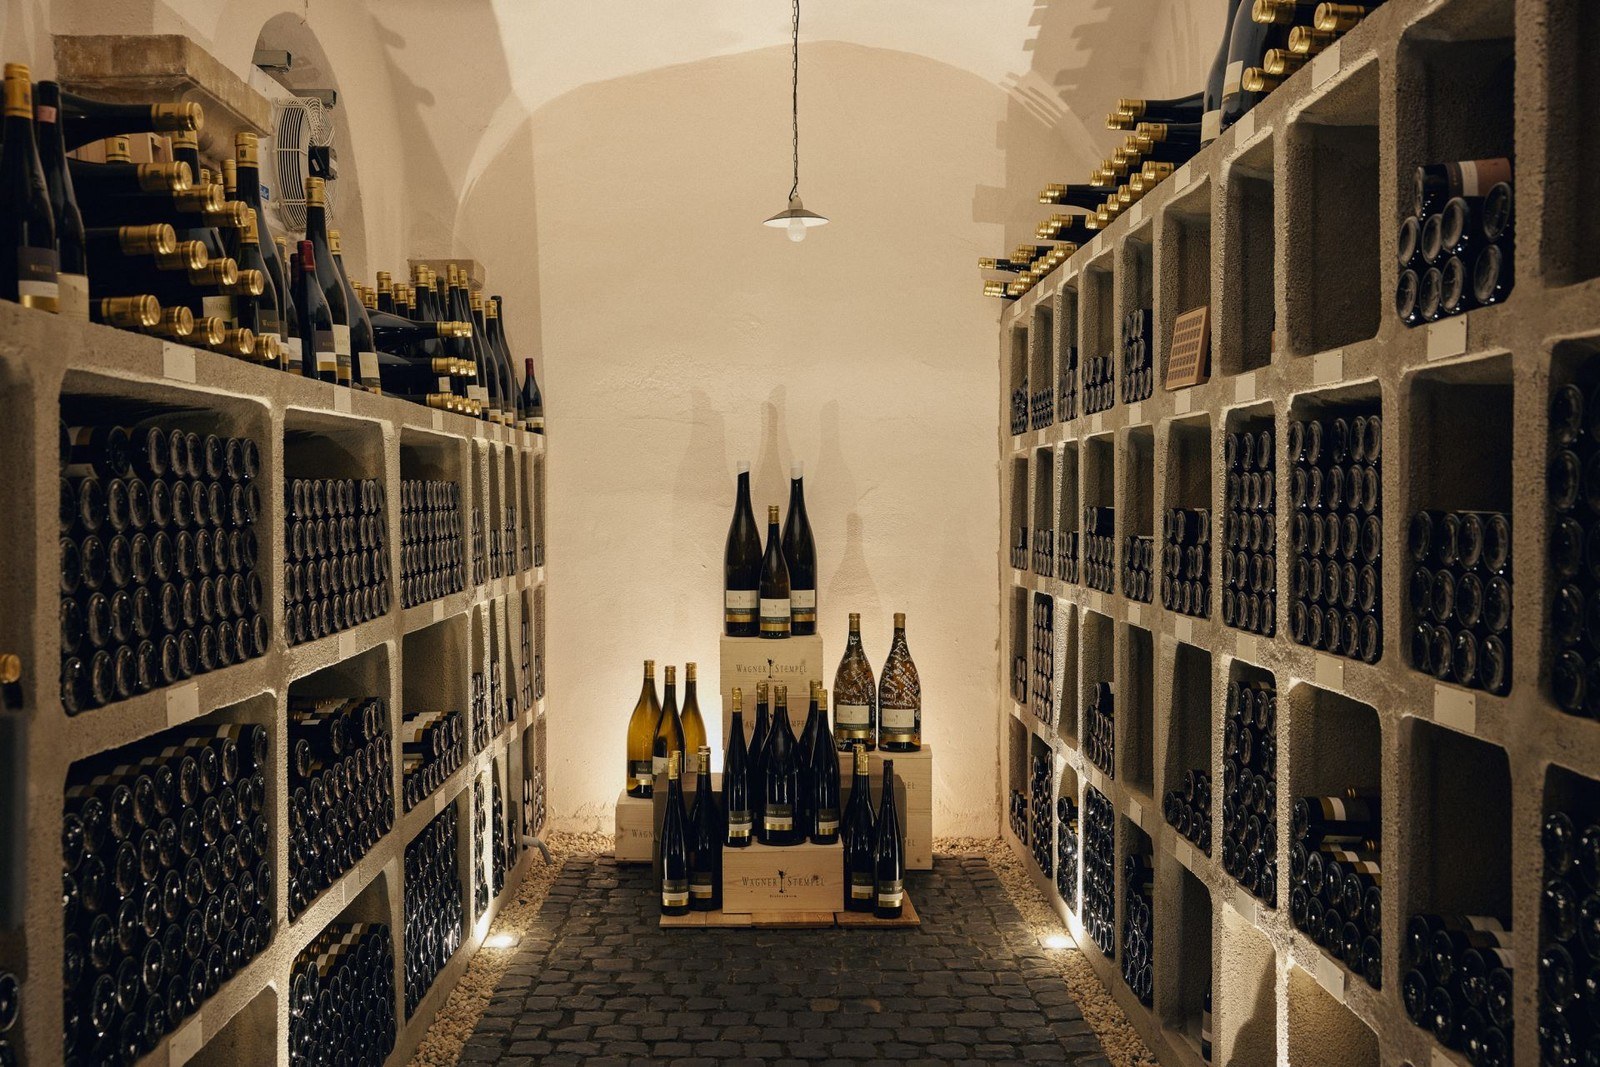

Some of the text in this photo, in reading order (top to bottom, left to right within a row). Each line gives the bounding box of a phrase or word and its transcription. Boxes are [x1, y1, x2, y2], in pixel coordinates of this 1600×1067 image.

[736, 664, 808, 673] WAGNER STEMPEL
[631, 829, 654, 838] WAGN
[742, 876, 826, 887] WAGNER STEMPEL
